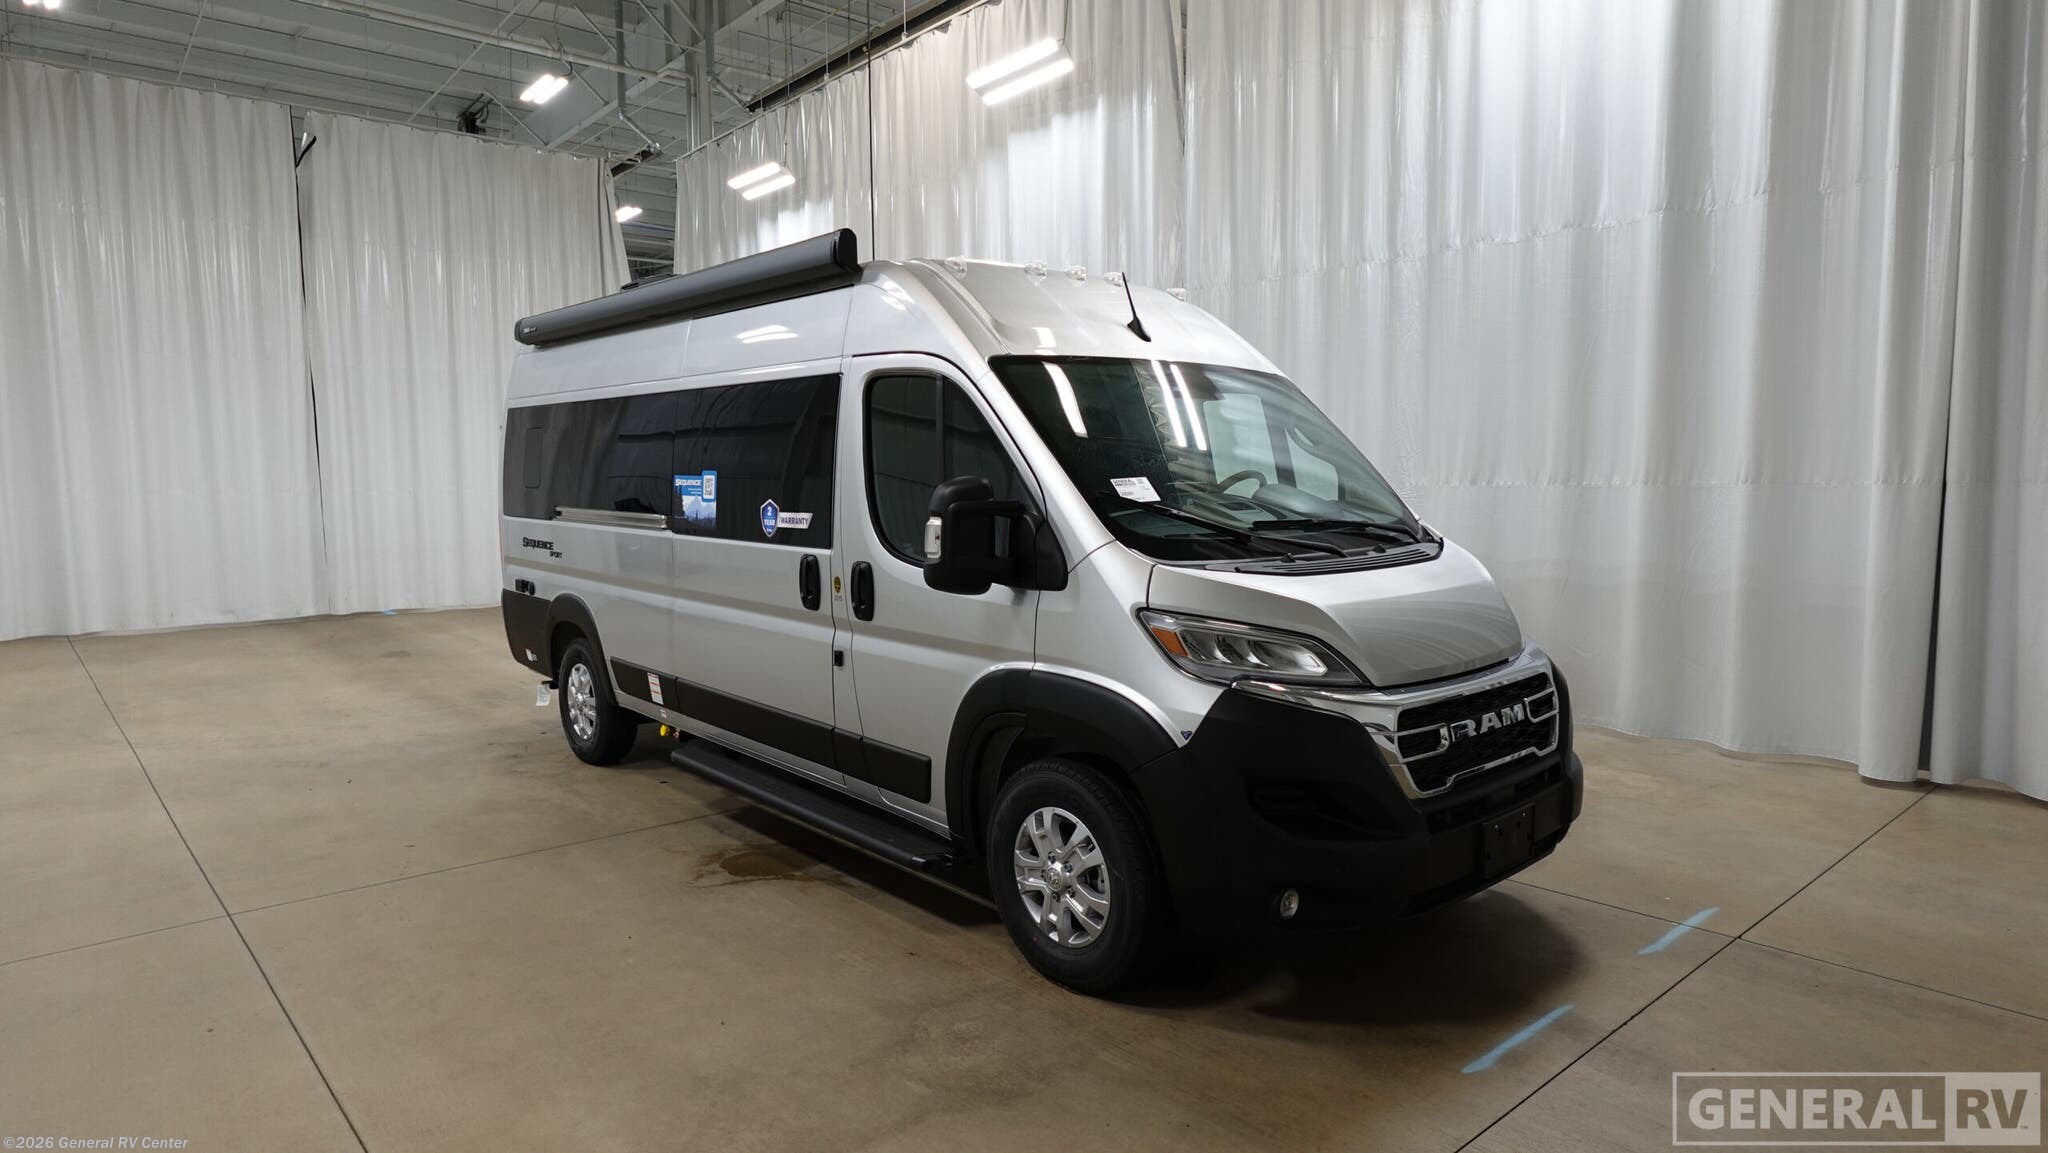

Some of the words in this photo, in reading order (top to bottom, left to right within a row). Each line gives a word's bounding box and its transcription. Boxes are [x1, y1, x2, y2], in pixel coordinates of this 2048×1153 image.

[767, 506, 773, 516] 2
[779, 516, 810, 526] WARRANTY
[522, 536, 554, 550] SEQUENCE
[1449, 703, 1525, 743] RAM
